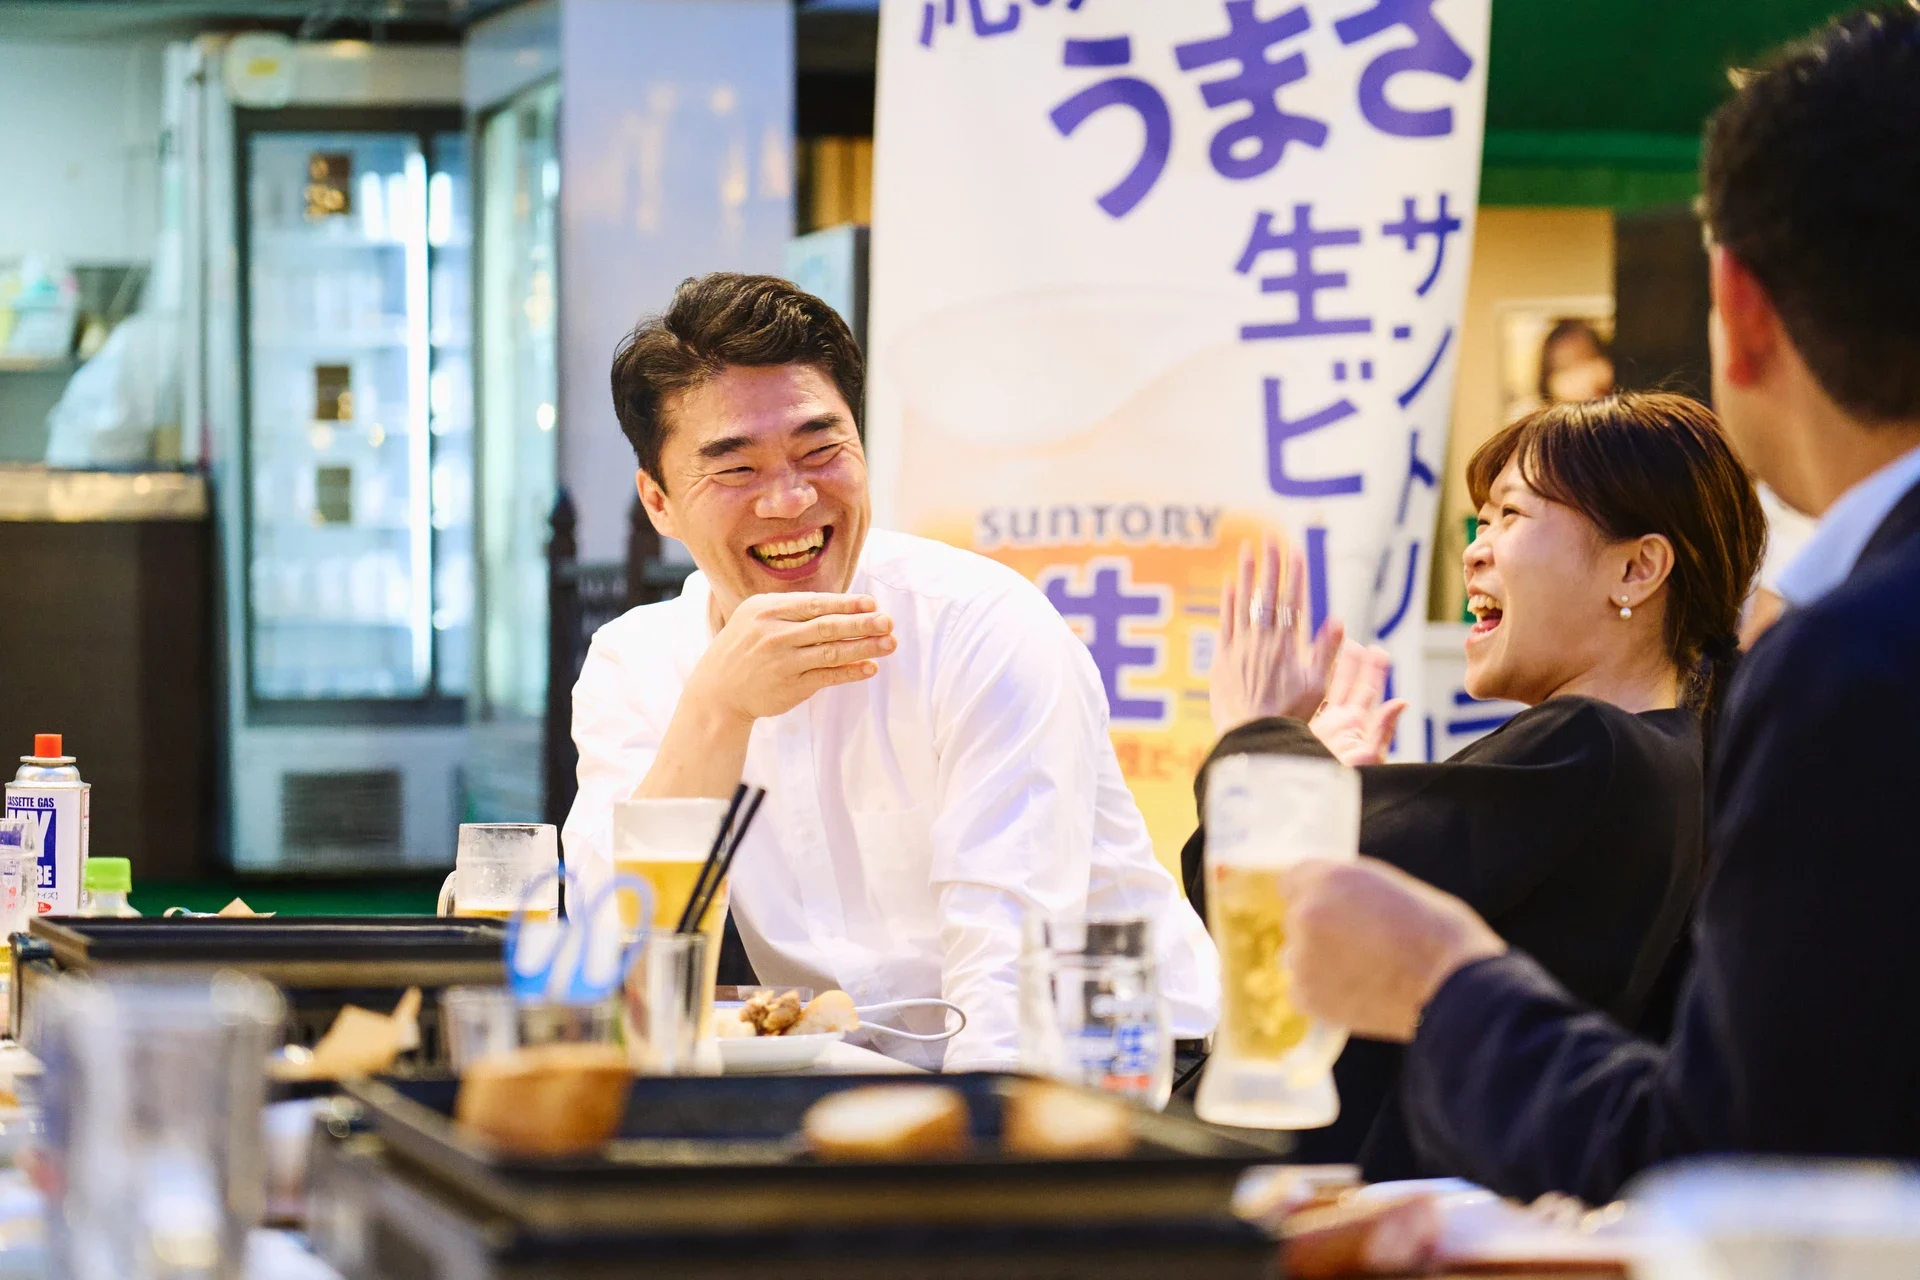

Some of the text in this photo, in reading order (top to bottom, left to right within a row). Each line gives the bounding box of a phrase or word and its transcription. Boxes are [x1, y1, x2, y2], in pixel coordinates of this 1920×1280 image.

[1050, 0, 1473, 219] うまさ
[980, 503, 1221, 544] SUNTORY
[38, 797, 54, 808] GAS
